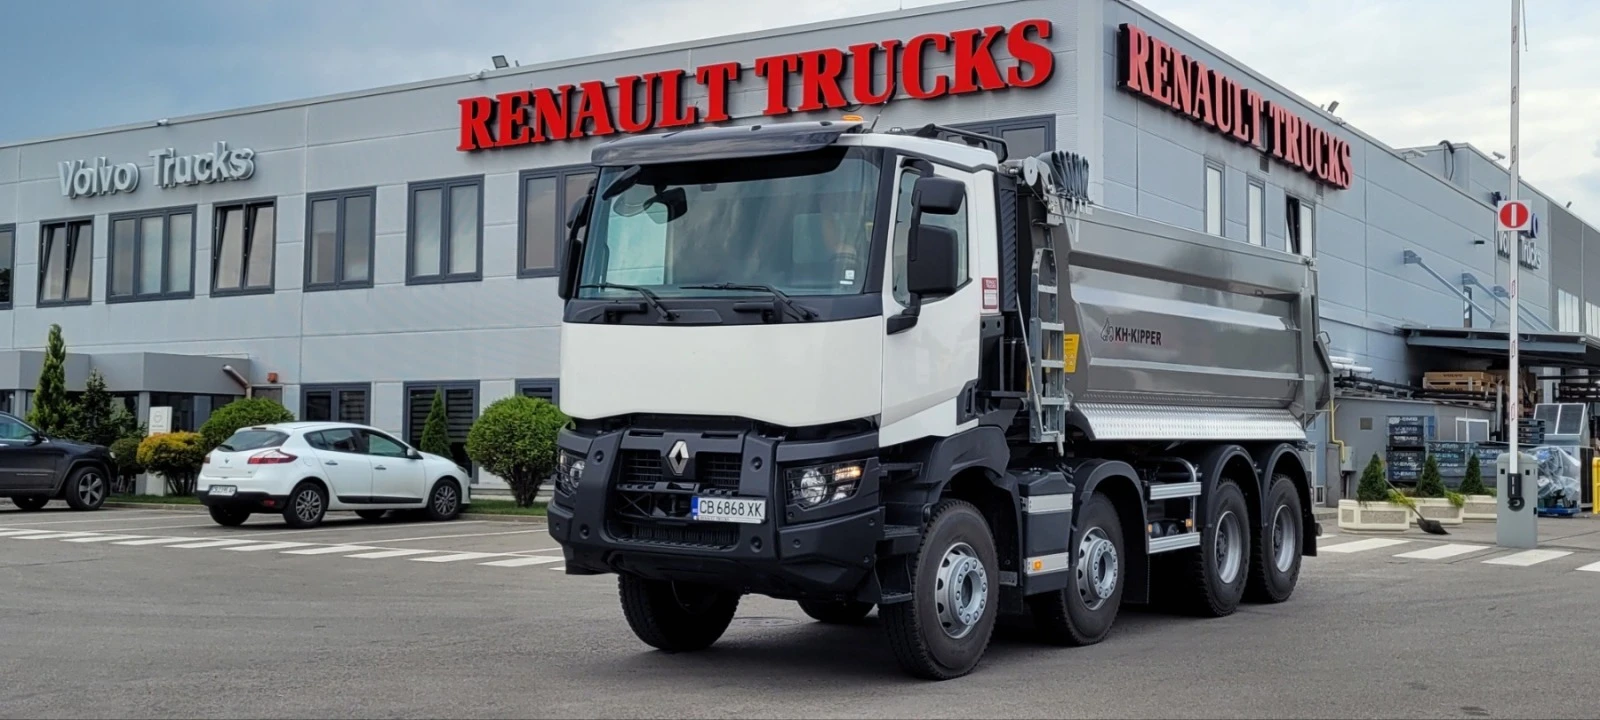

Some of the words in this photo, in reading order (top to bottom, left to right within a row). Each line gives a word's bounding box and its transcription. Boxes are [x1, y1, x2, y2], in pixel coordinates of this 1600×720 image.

[456, 62, 742, 152] RENAULT
[754, 19, 1053, 115] TRUCKS
[1124, 23, 1264, 148] RENAULT
[1267, 101, 1352, 190] TRUCKS
[58, 157, 139, 199] Volvo
[149, 141, 255, 188] Trucks
[1114, 327, 1162, 346] KH-KIPPER
[700, 500, 714, 515] CB
[717, 501, 745, 516] 6868
[747, 502, 762, 517] XK
